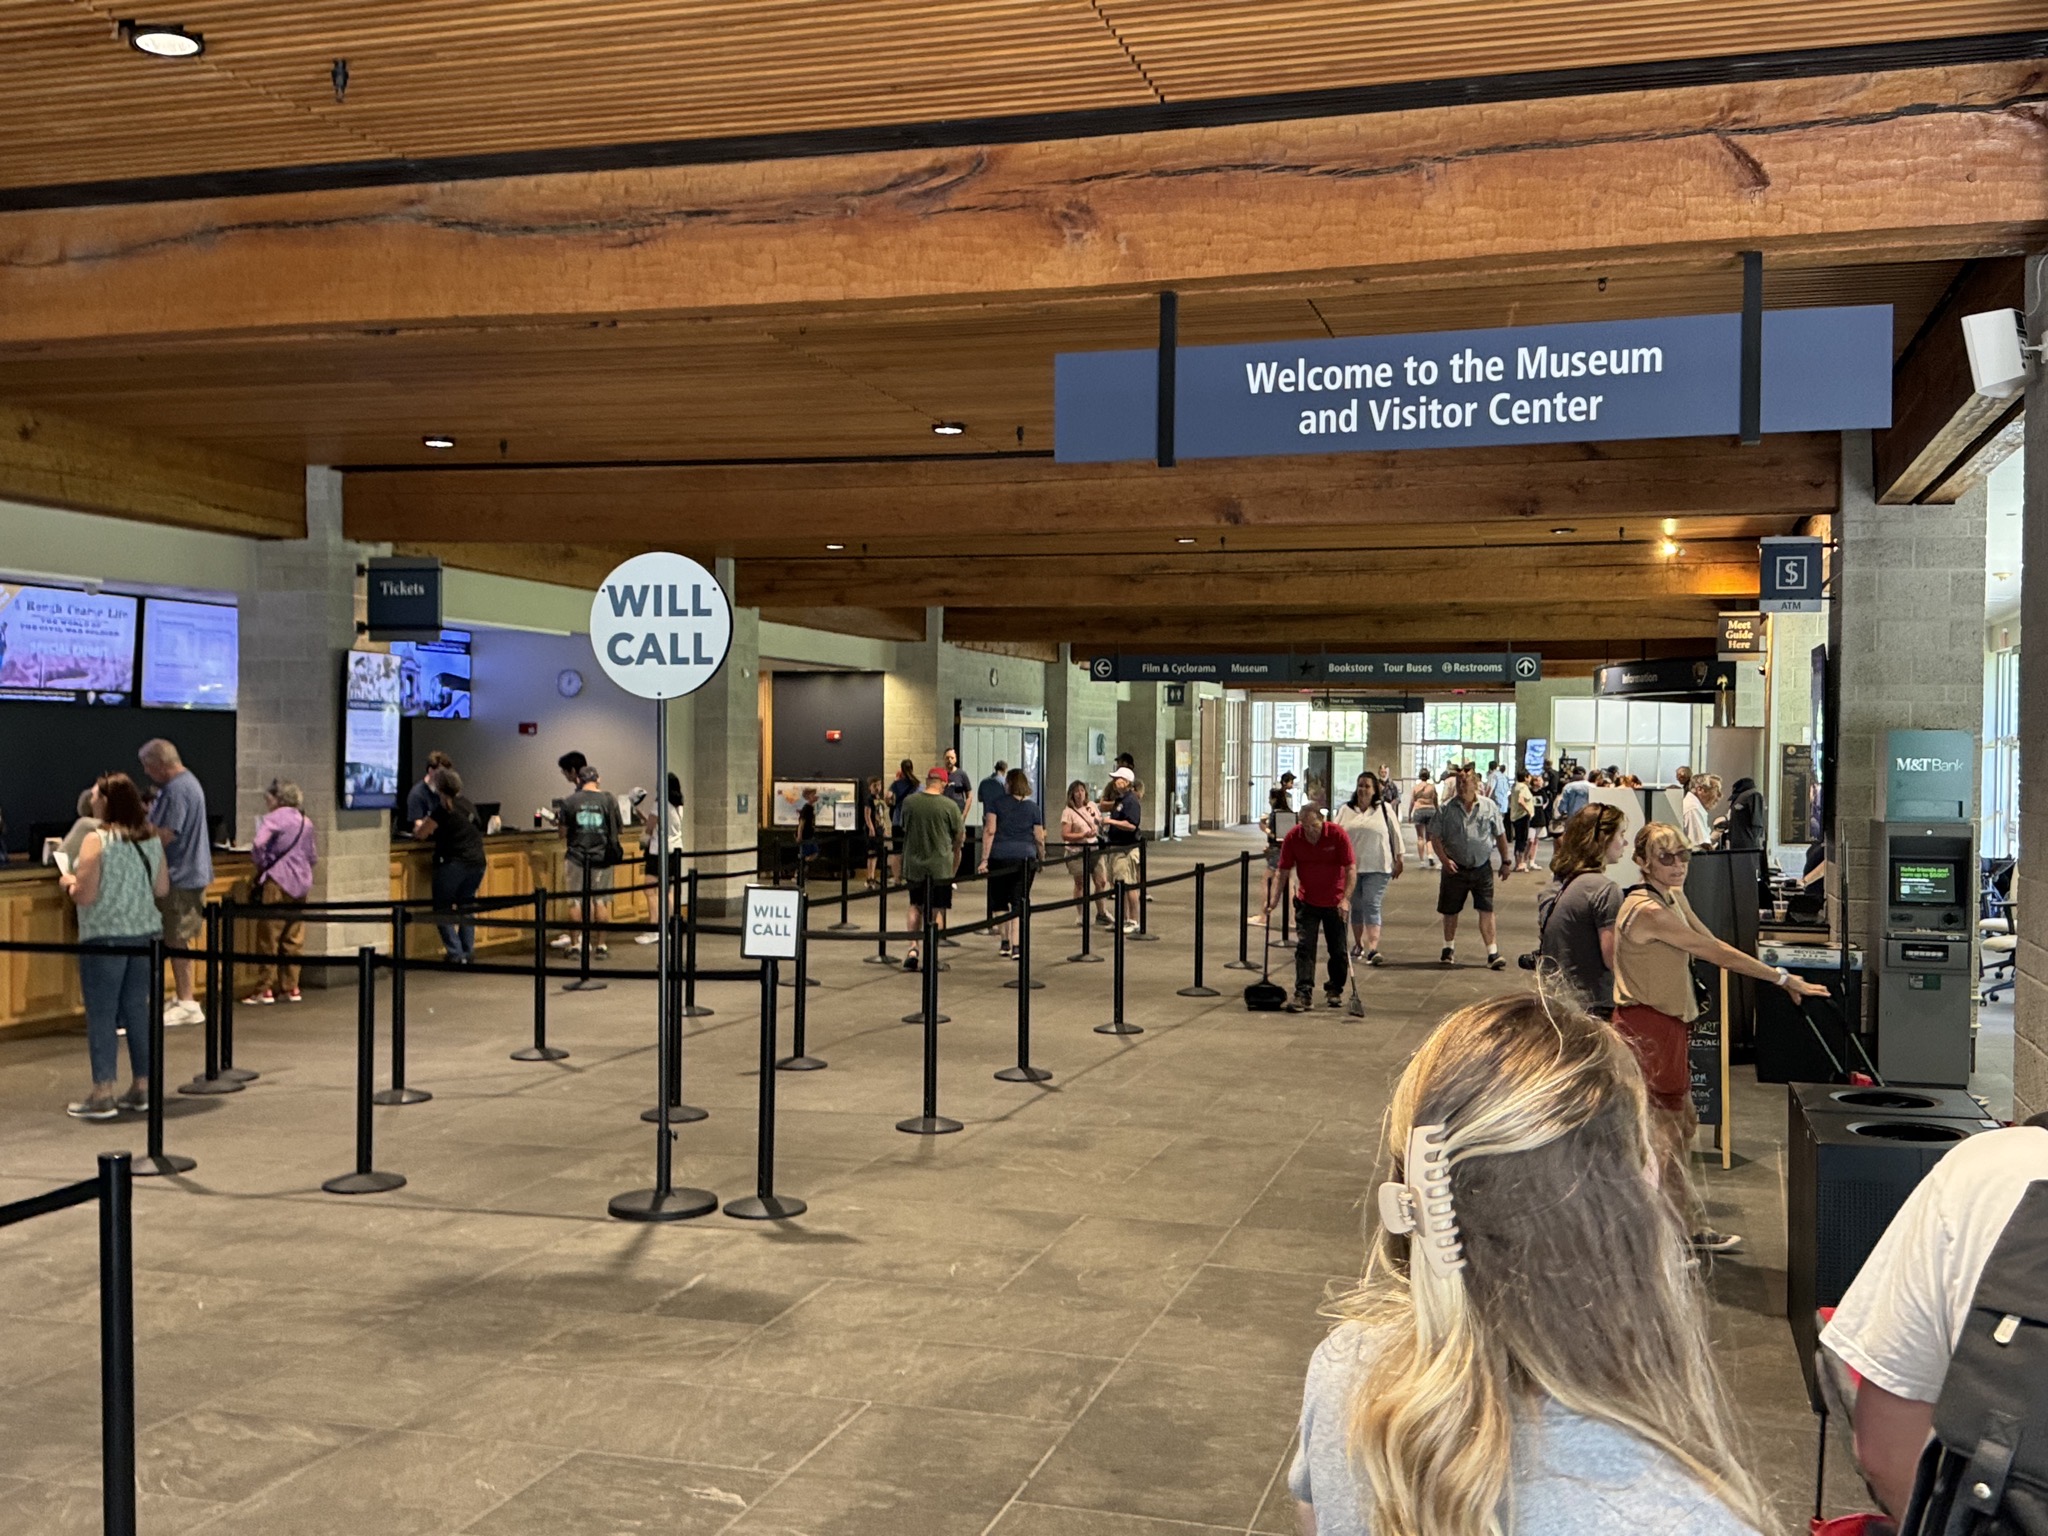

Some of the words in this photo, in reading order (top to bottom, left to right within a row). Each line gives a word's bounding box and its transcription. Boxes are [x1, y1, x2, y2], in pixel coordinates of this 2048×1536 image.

[1246, 357, 1393, 394] Welcome
[1403, 354, 1438, 387] to
[1449, 347, 1505, 384] the
[1517, 346, 1663, 380] Museum
[1299, 399, 1358, 435] and
[1369, 396, 1478, 432] Visitor
[1489, 391, 1603, 426] Center
[379, 580, 426, 597] Tickets
[606, 584, 713, 618] WILL
[1780, 601, 1802, 611] ATM
[1727, 620, 1752, 630] Meet
[1725, 630, 1754, 640] Guide
[606, 632, 714, 666] CALL
[1728, 640, 1751, 649] Here
[1142, 663, 1160, 673] Film
[1162, 663, 1169, 673] &
[1171, 663, 1217, 675] Cyclorama
[1231, 663, 1268, 673] Museum
[1328, 662, 1374, 673] Bookstore
[1383, 662, 1404, 673] Tour
[1406, 662, 1433, 673] Buses
[1453, 662, 1503, 673] Restrooms
[1896, 757, 1931, 772] M&T
[1931, 758, 1964, 772] Bank
[753, 904, 792, 919] WILL
[751, 923, 792, 937] CALL
